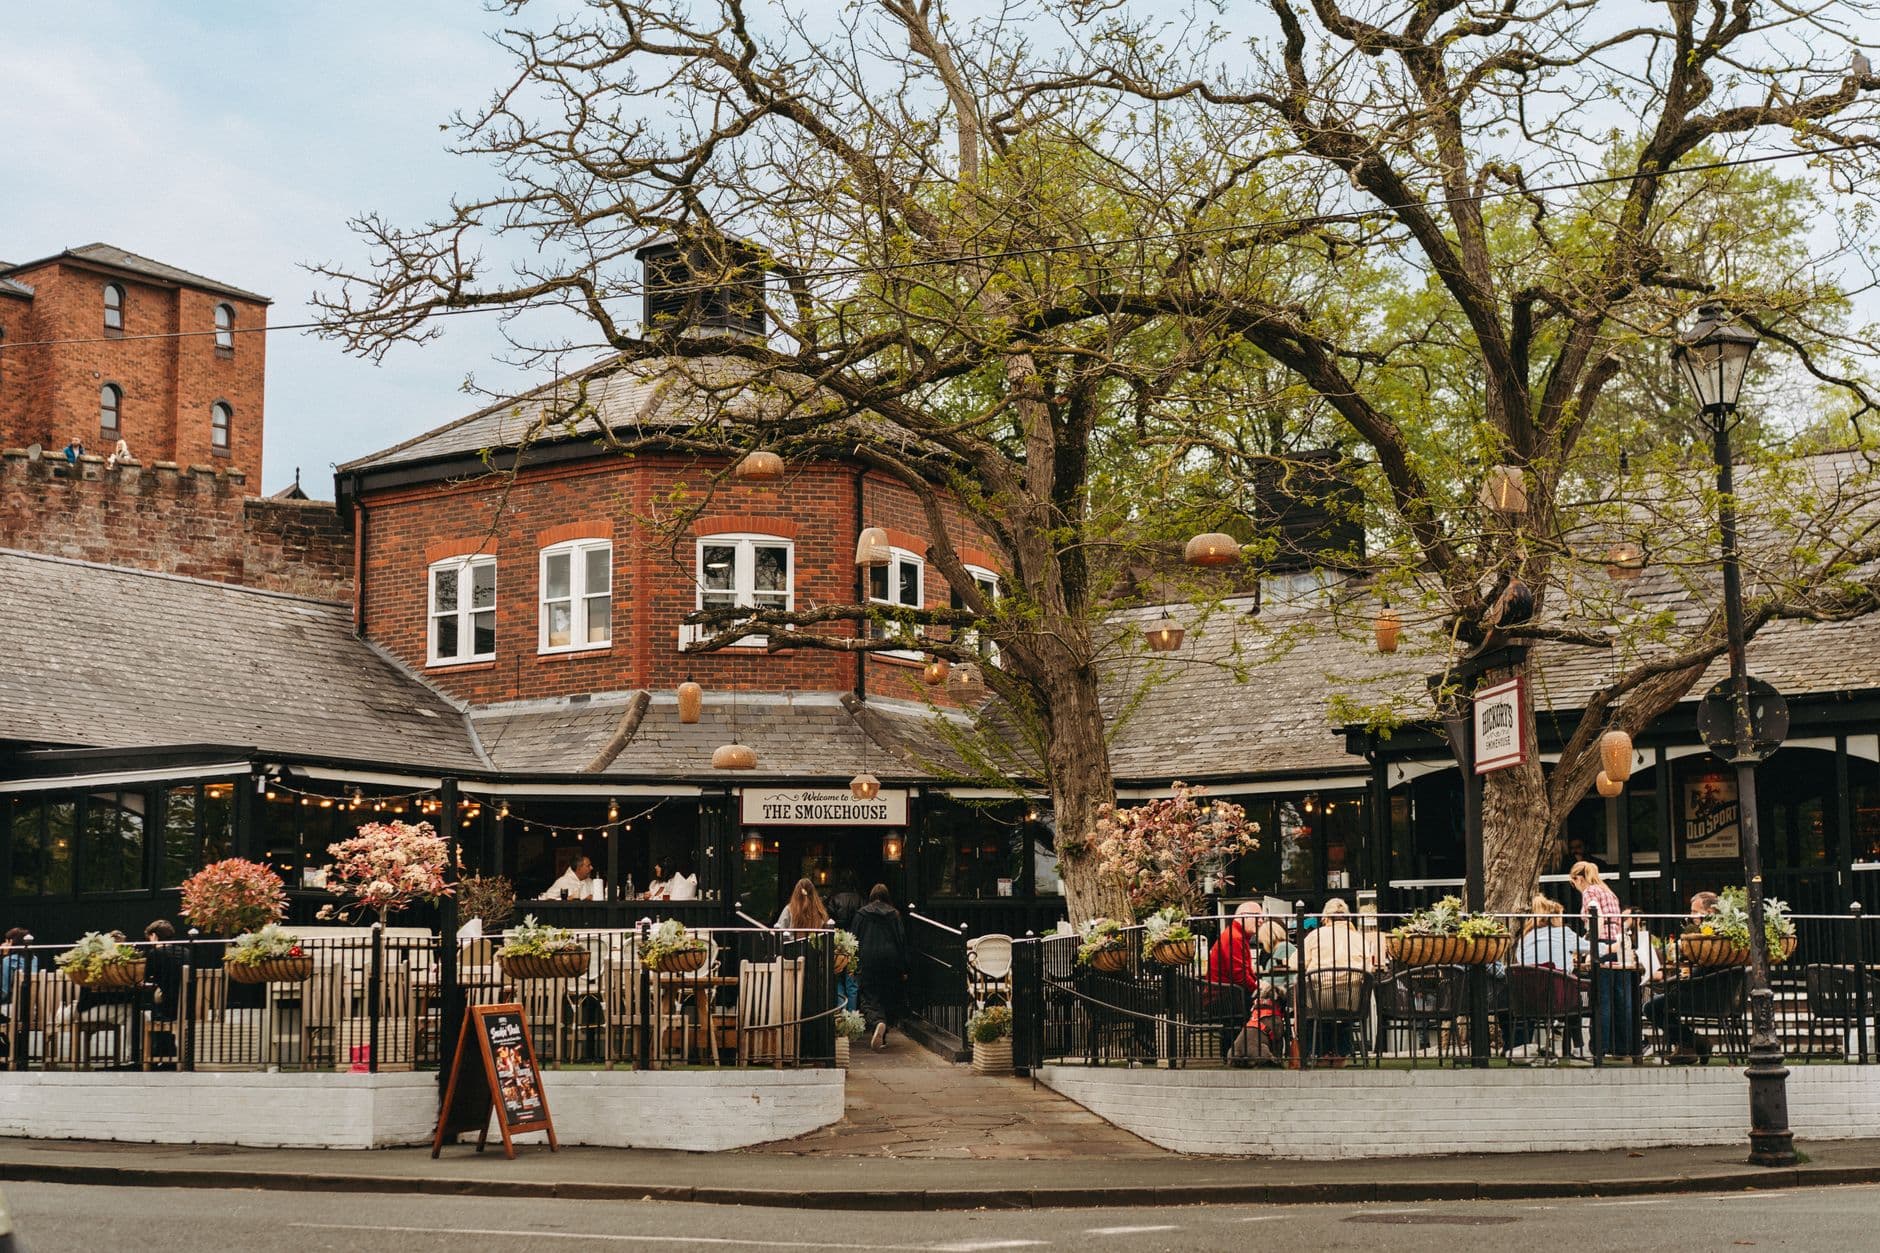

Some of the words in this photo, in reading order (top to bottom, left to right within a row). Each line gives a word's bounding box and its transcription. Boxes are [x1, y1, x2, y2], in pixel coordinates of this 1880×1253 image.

[1482, 703, 1513, 736] HICKORY'S
[801, 791, 840, 801] Welcome
[763, 804, 791, 820] THE
[795, 804, 887, 820] SMOKEHOUSE
[1686, 821, 1705, 840] OLD
[1707, 806, 1737, 833] SPORT
